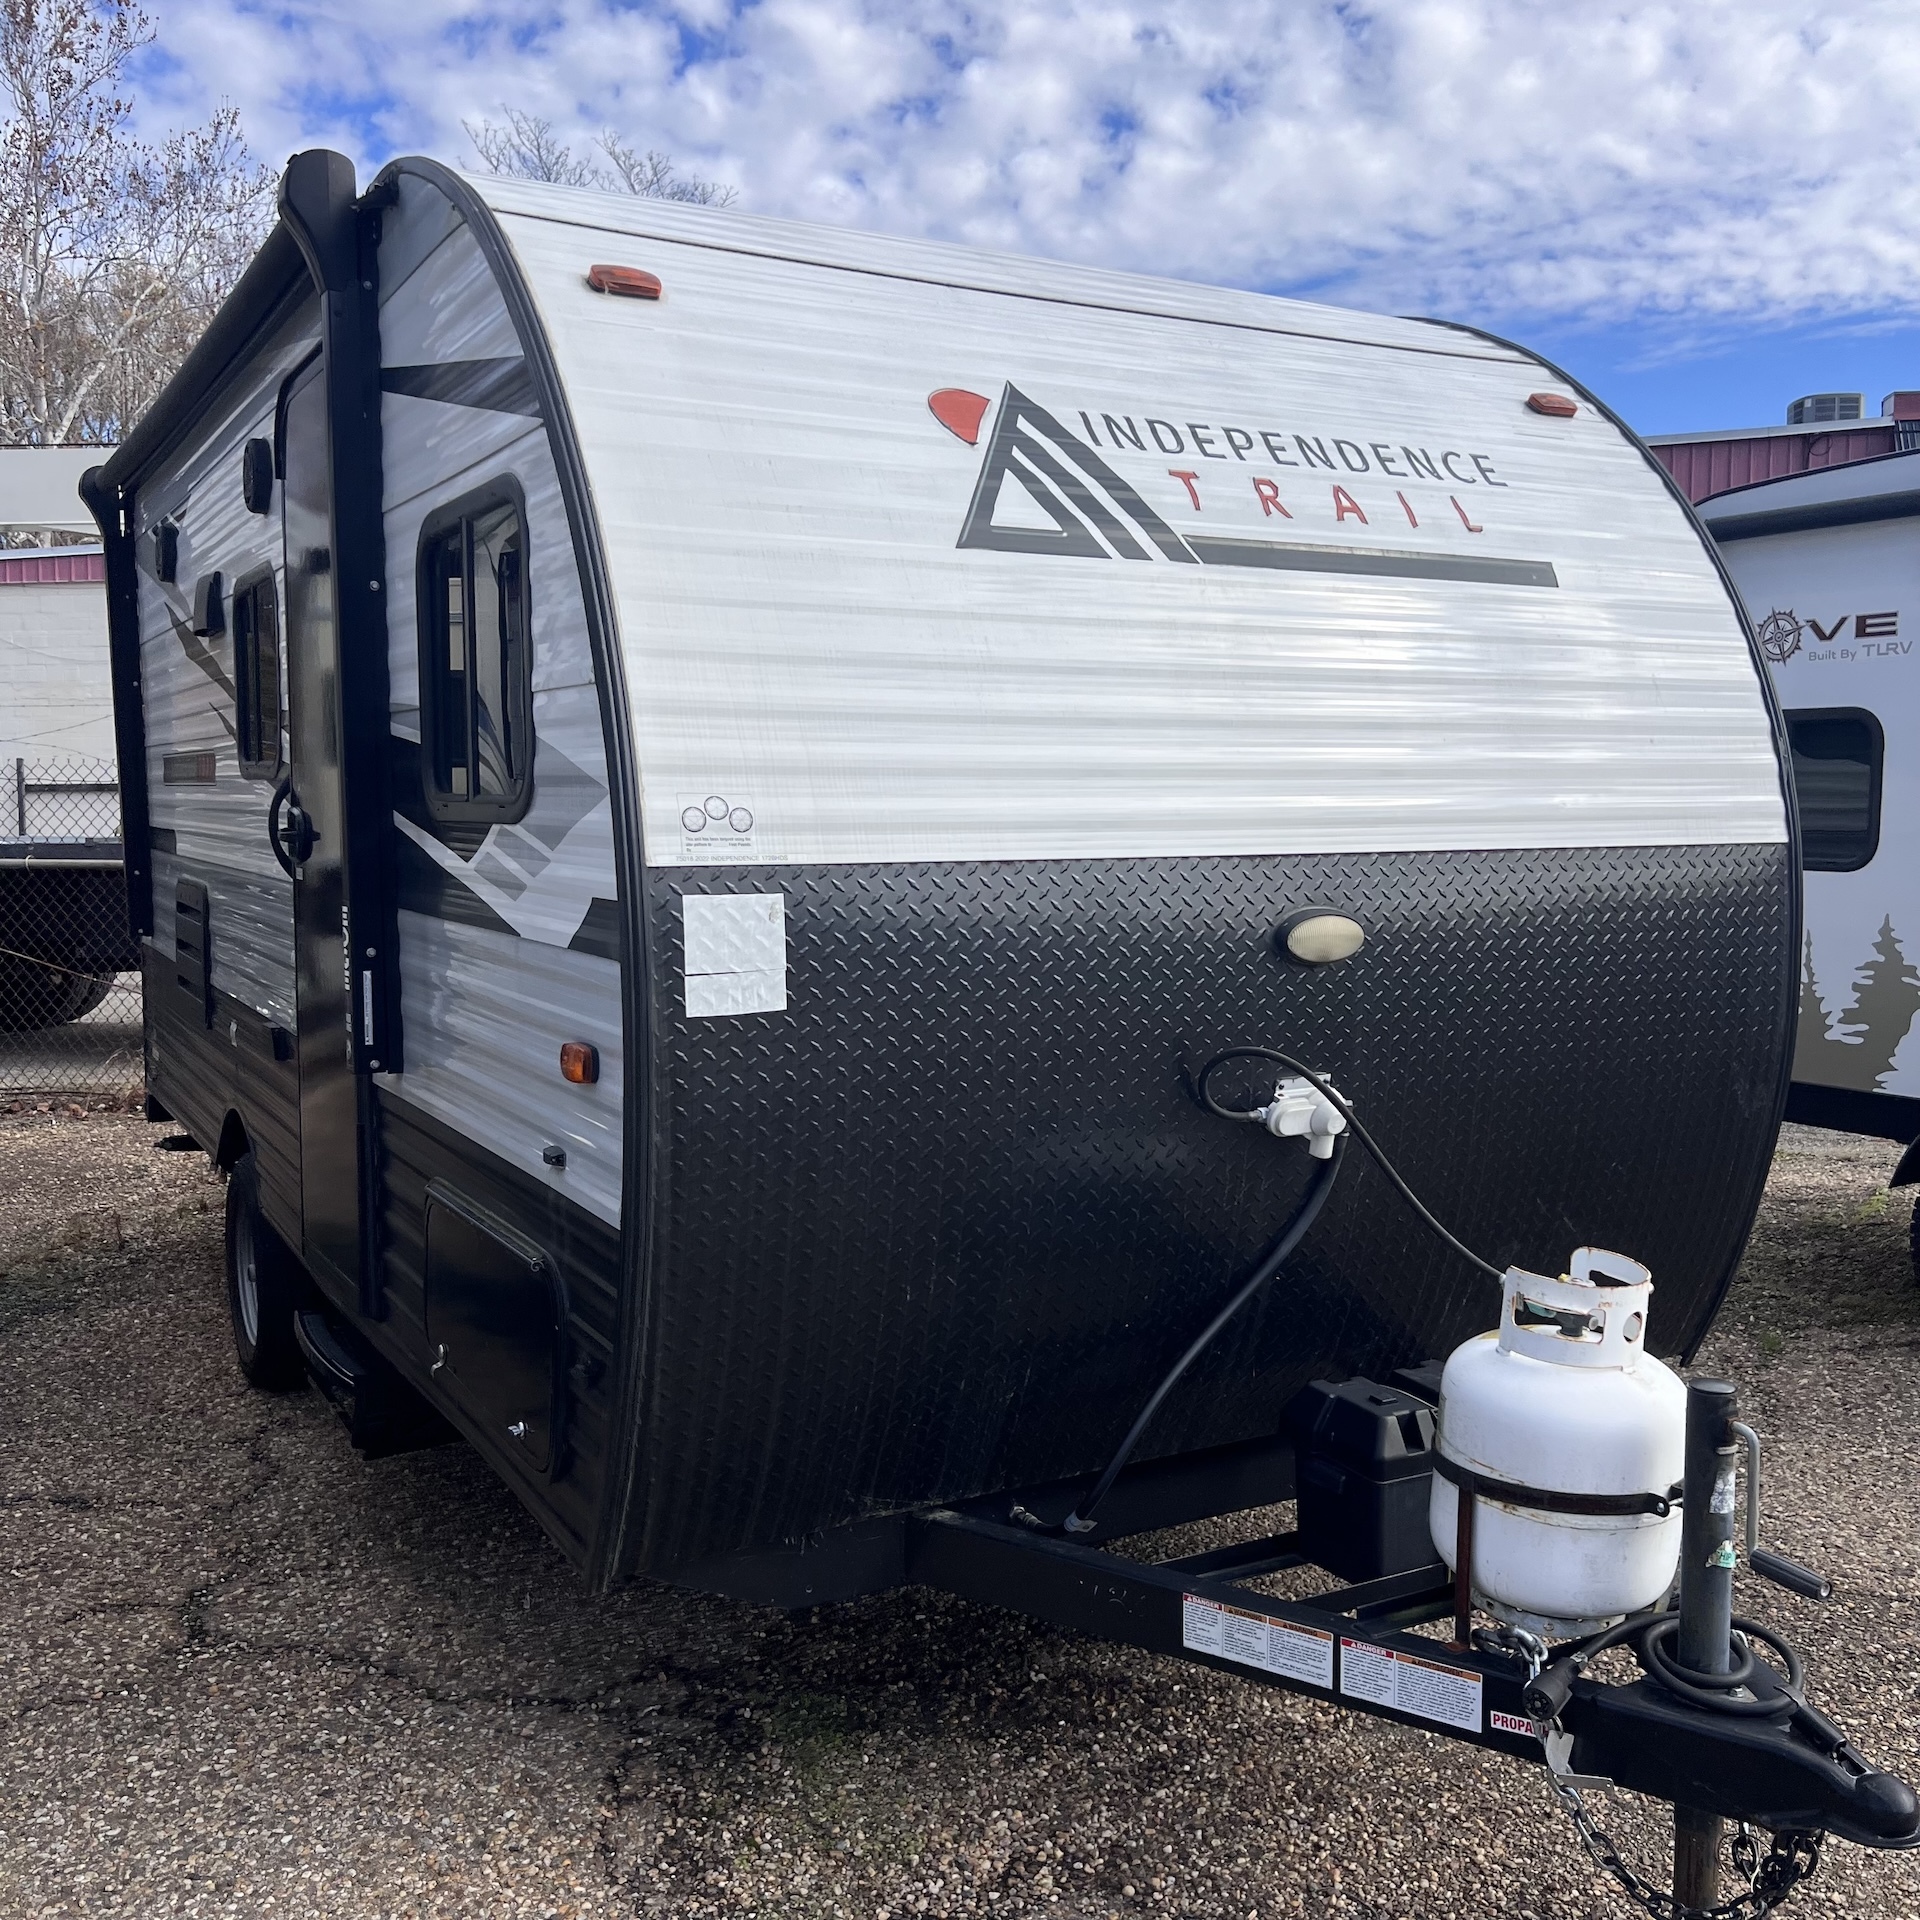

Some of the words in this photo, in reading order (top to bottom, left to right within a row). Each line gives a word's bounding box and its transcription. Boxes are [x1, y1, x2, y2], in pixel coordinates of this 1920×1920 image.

[1078, 410, 1509, 487] INDEPENDENCE
[1168, 469, 1483, 533] TRAIL
[1808, 650, 1836, 662] Built
[1841, 649, 1857, 662] By
[1862, 641, 1913, 657] TLRV
[1192, 1596, 1220, 1610] DANGER
[1357, 1643, 1387, 1657] DANGER
[1493, 1713, 1549, 1736] PROPA
